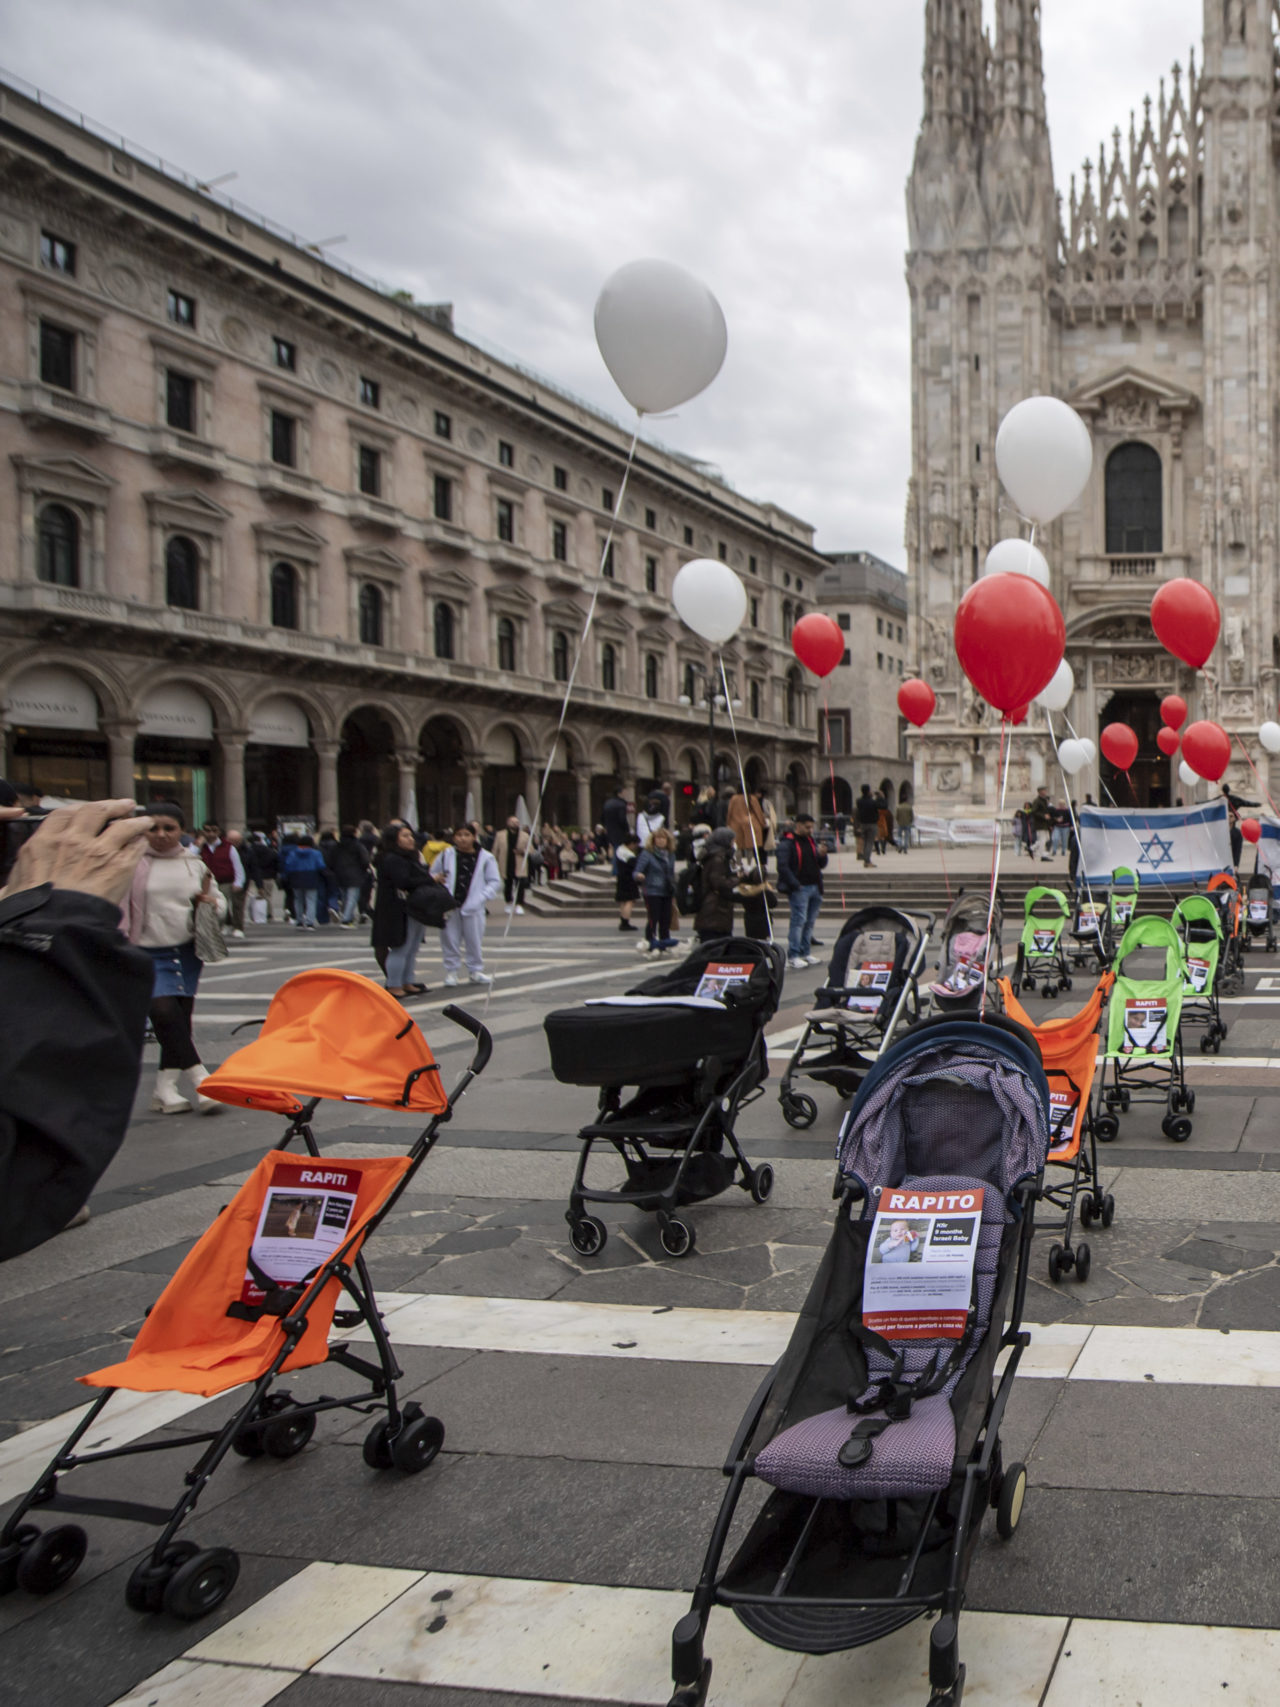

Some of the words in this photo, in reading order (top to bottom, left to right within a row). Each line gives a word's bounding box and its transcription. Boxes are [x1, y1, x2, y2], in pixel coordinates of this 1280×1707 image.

[1050, 1092, 1067, 1102] PITI
[300, 1170, 347, 1186] RAPITI
[889, 1194, 975, 1210] RAPITO
